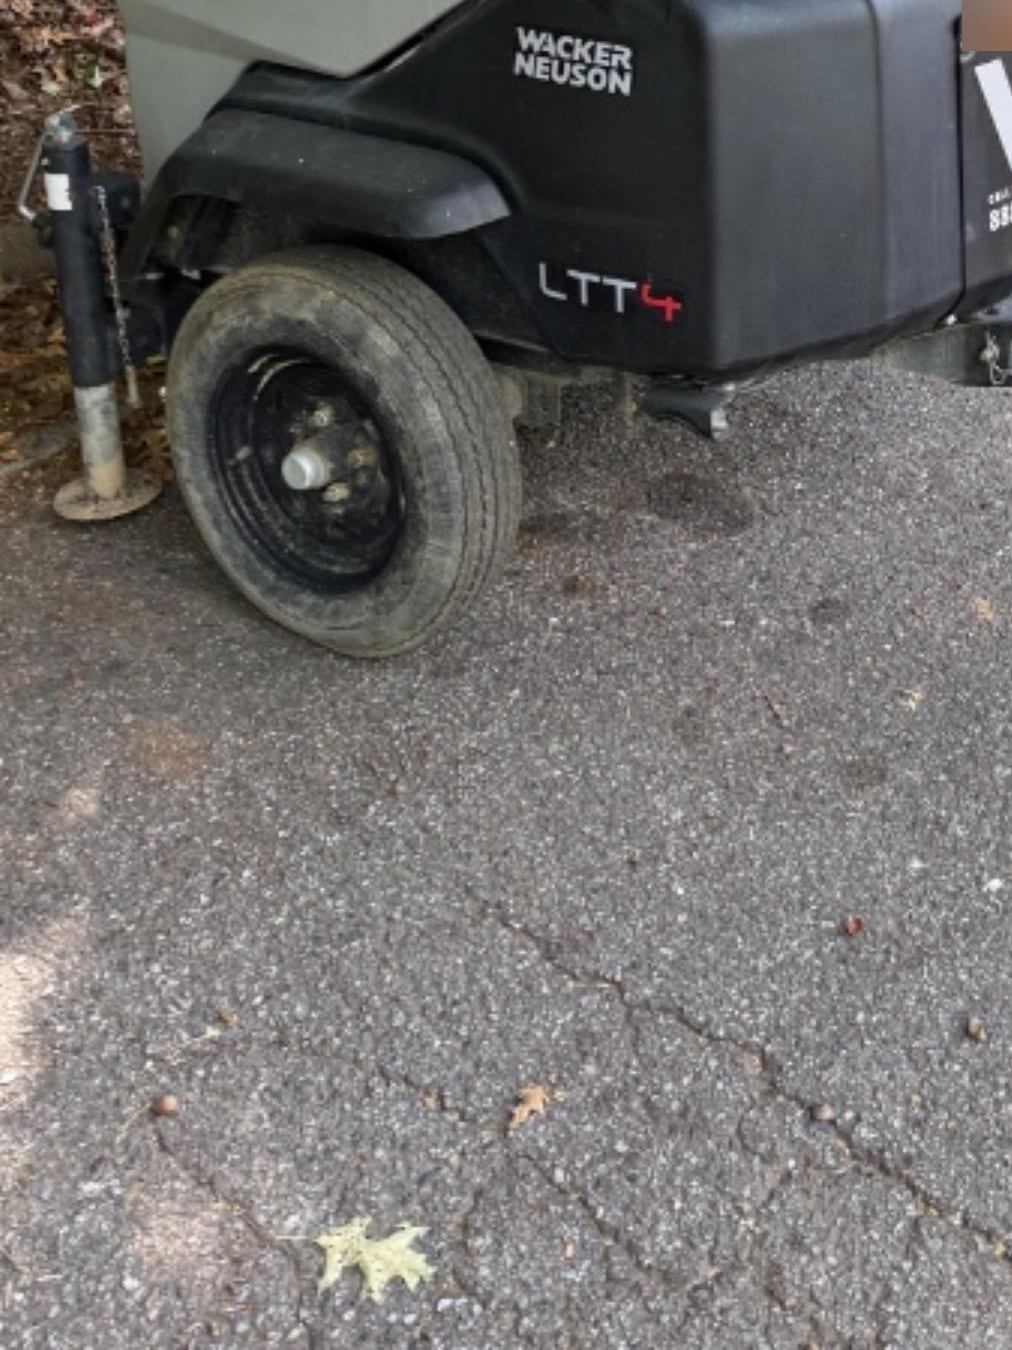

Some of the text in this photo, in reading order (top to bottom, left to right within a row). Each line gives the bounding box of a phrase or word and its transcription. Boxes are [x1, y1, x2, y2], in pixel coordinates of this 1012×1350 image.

[515, 25, 633, 70] WACKER
[513, 52, 632, 97] NEUSON
[538, 262, 682, 323] LTT4
